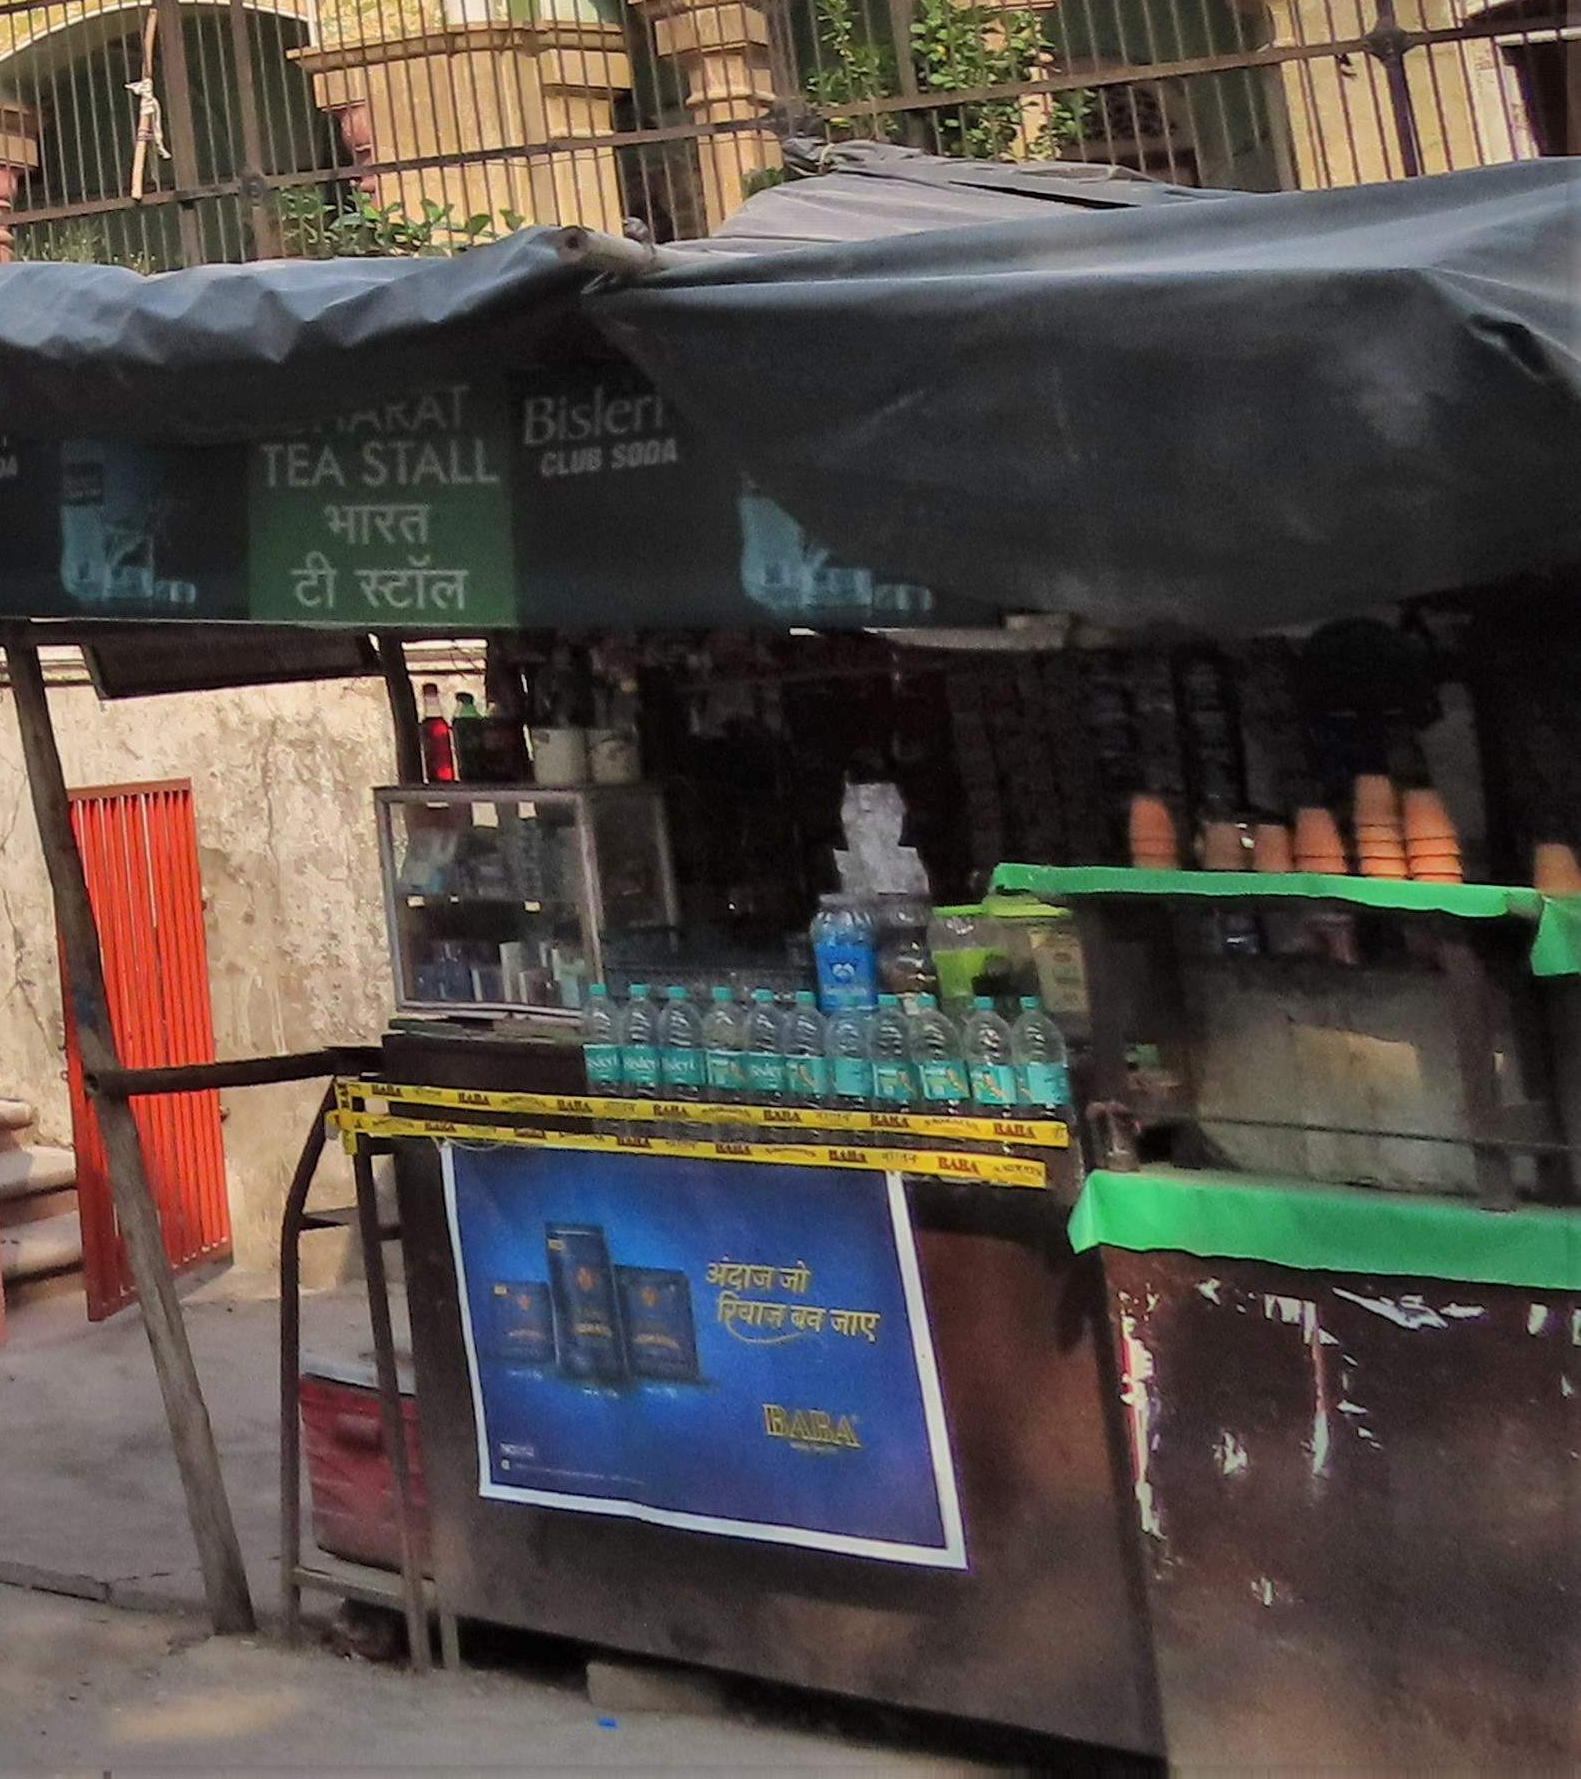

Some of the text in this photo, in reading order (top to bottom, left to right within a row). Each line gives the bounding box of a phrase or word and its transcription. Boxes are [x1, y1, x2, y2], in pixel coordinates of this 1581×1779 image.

[287, 381, 471, 435] ARAT
[523, 391, 665, 447] Bisleri
[259, 435, 500, 490] TEA STALL
[540, 437, 679, 478] CLUB SODA
[325, 503, 431, 548] भारत
[290, 551, 469, 611] टी स्टॉल
[706, 1258, 813, 1296] अंदाज जो
[715, 1291, 880, 1344] रिवाज बन जाए
[762, 1402, 861, 1451] BABA
